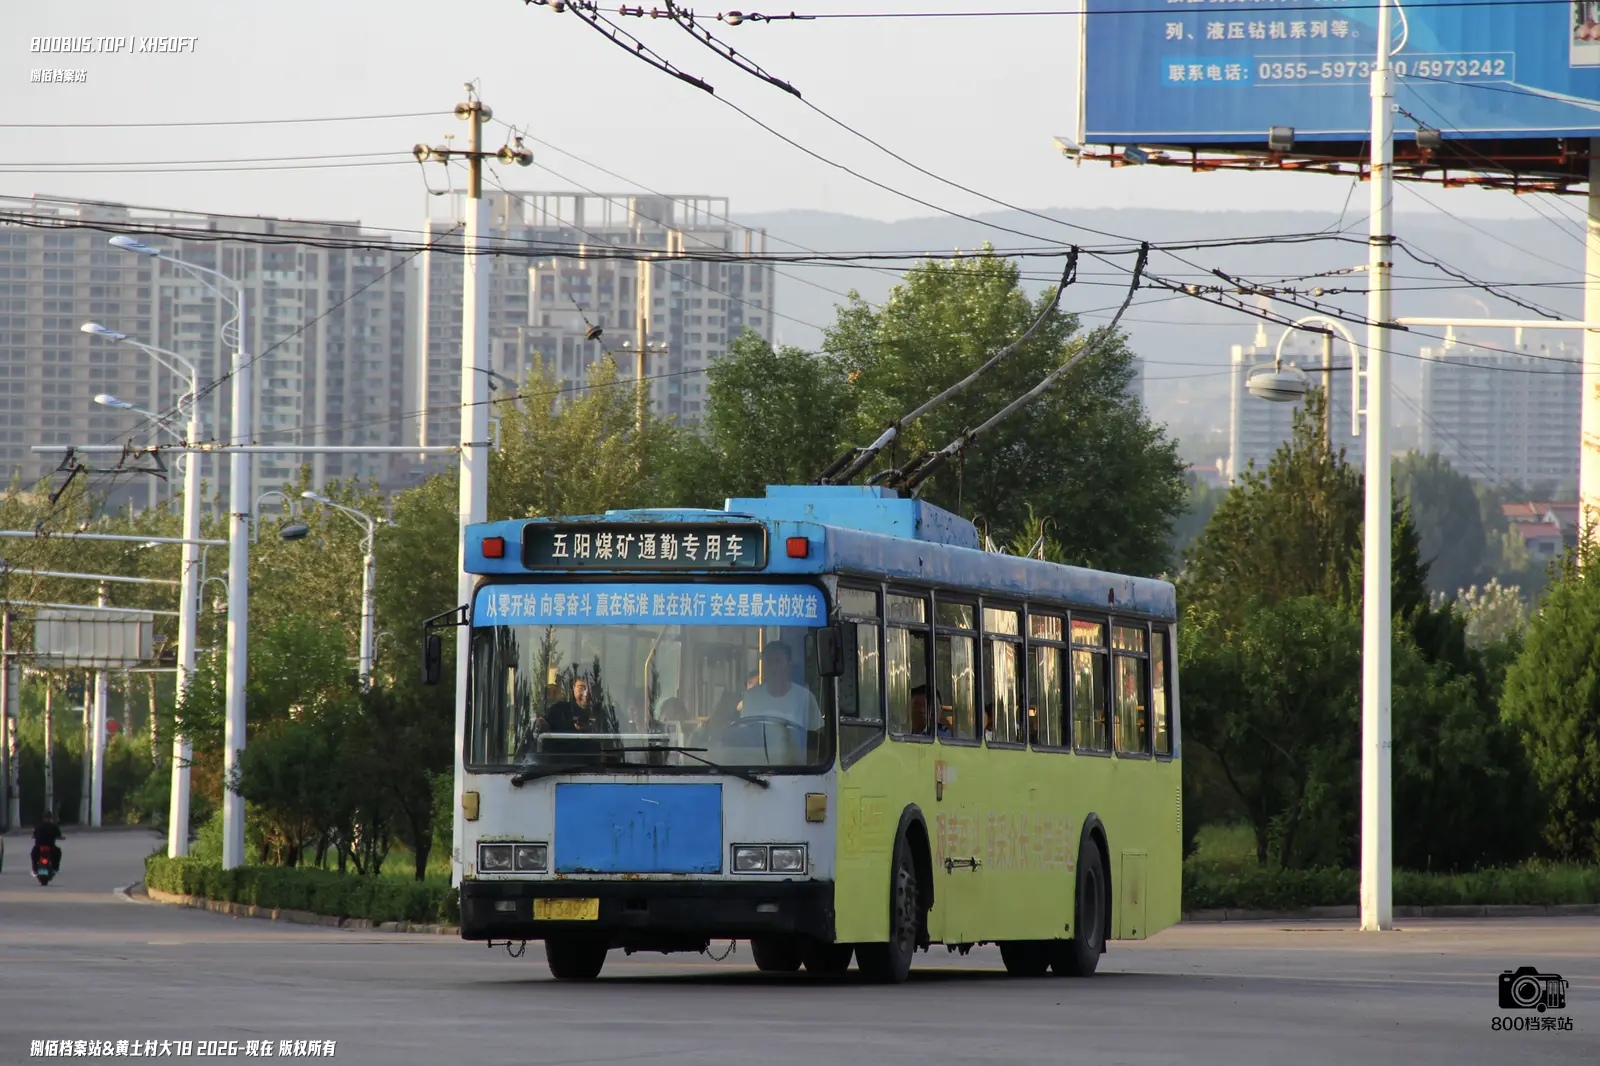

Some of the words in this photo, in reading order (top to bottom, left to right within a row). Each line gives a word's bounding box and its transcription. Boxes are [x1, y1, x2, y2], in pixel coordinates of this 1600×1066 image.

[551, 532, 744, 562] 五阳煤矿通勤专用车
[486, 593, 537, 618] 从零开始
[540, 592, 592, 617] 向零奋斗
[596, 592, 649, 617] 赢在标准
[652, 592, 706, 617] 胜在执行
[710, 592, 818, 619] 安全是最大的效益
